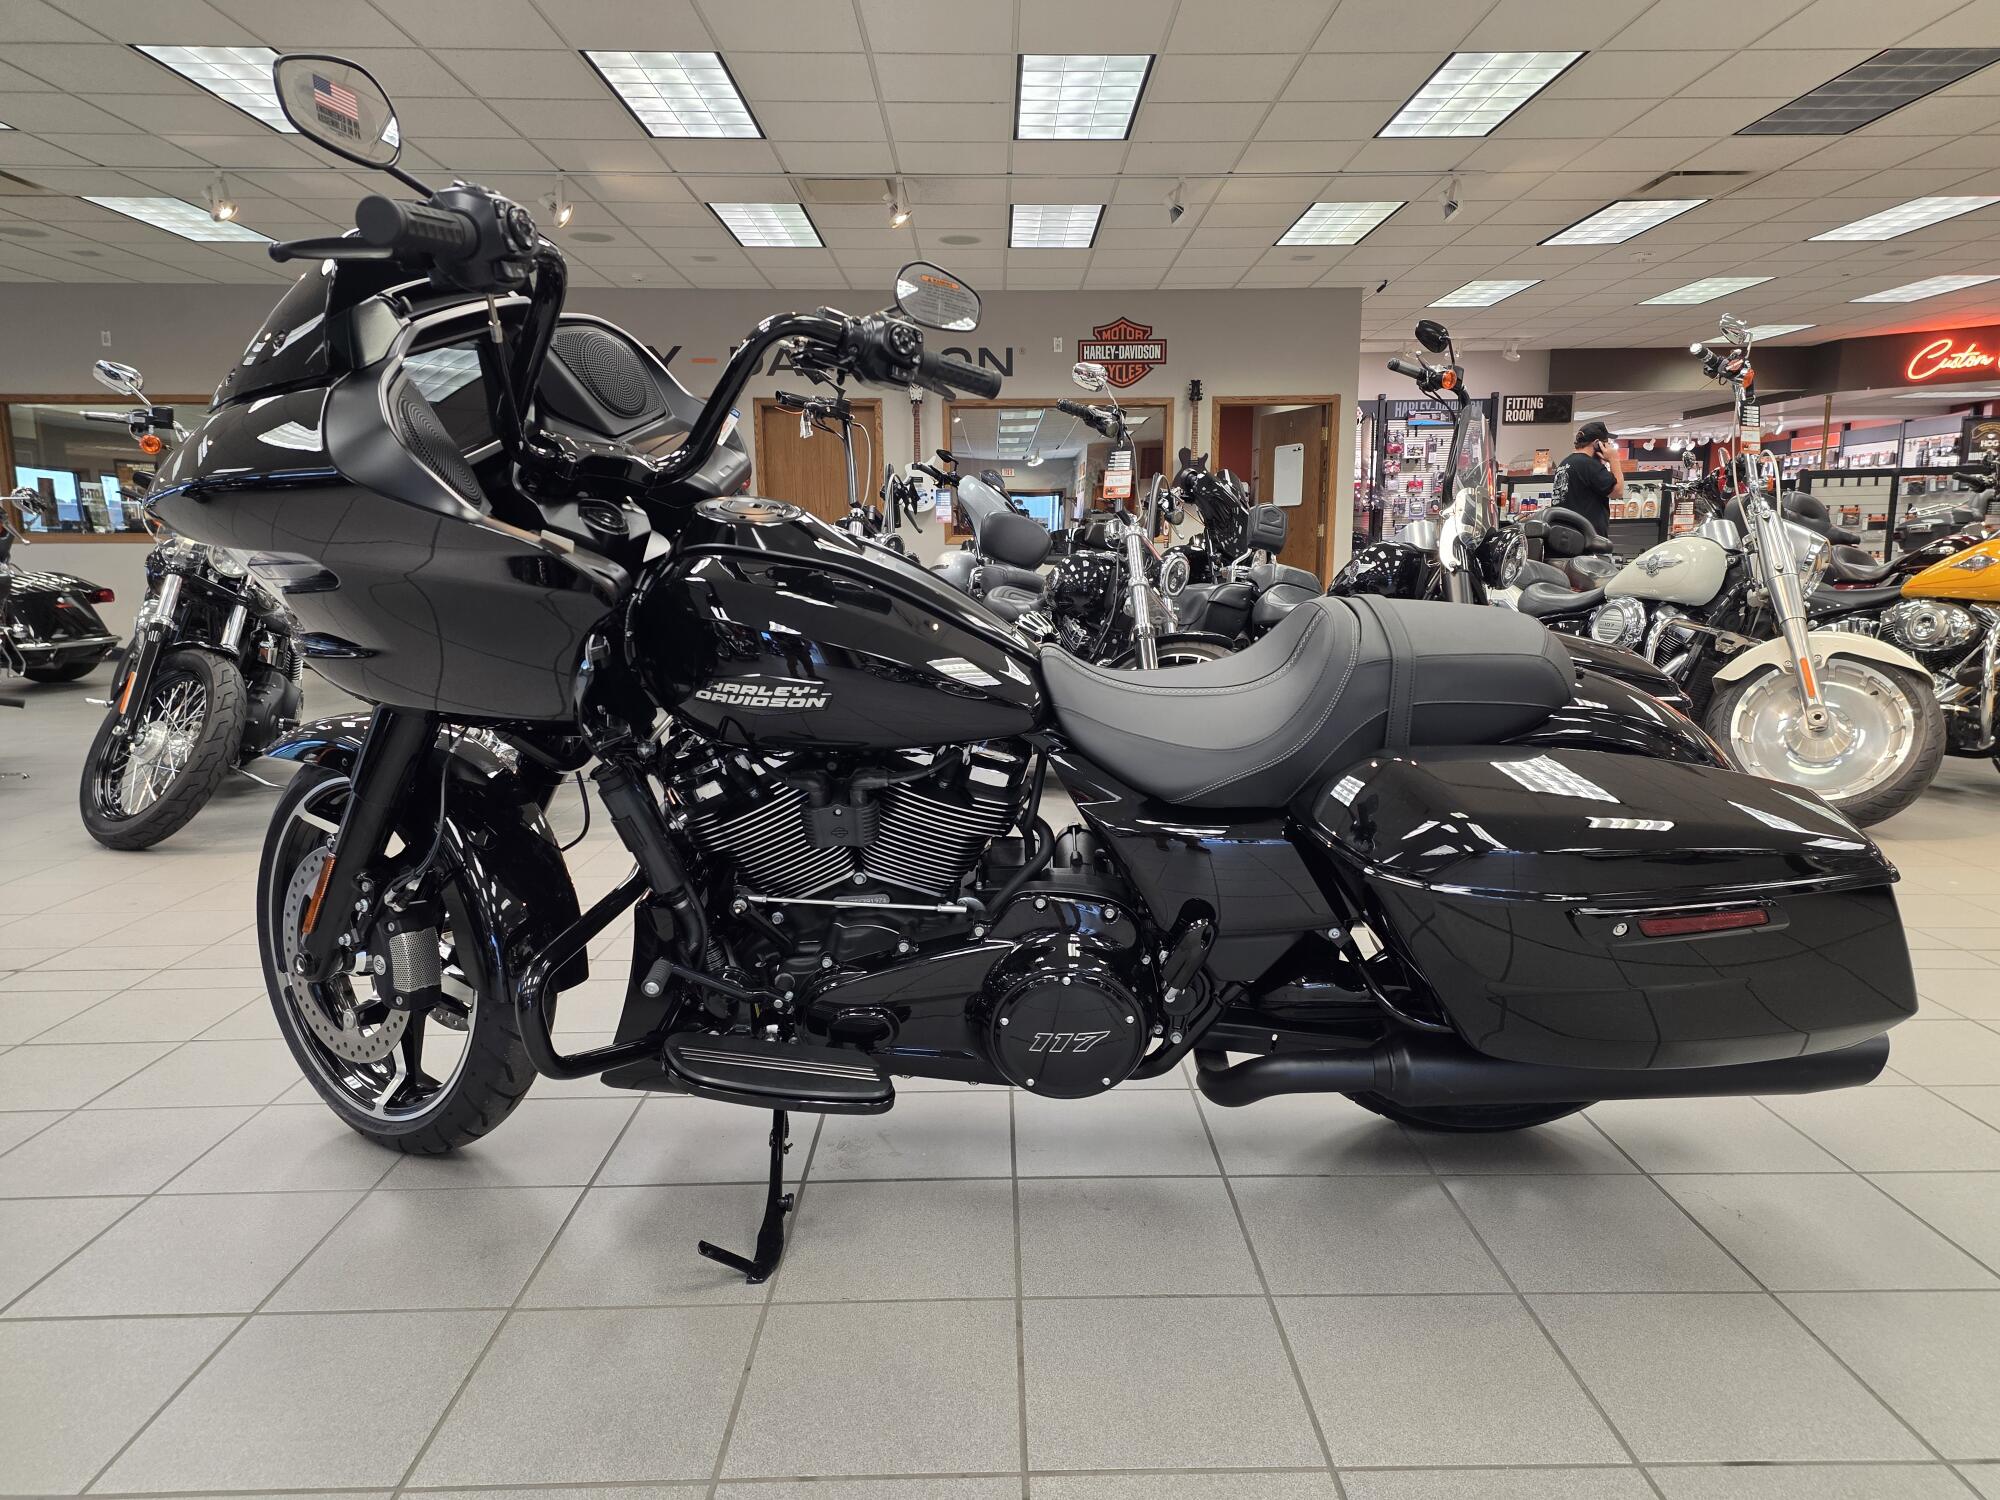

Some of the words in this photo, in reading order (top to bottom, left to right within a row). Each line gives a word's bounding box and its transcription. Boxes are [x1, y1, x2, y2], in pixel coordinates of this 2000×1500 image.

[1102, 324, 1144, 340] MOTOR
[1083, 344, 1161, 360] HARLEY-DAVIDSON
[1908, 339, 1995, 380] Custom
[1105, 364, 1143, 382] YCLES
[1506, 397, 1544, 410] FITTING
[1505, 409, 1535, 422] ROOM
[695, 690, 827, 708] DAVIDSON
[1028, 1030, 1111, 1053] 117
